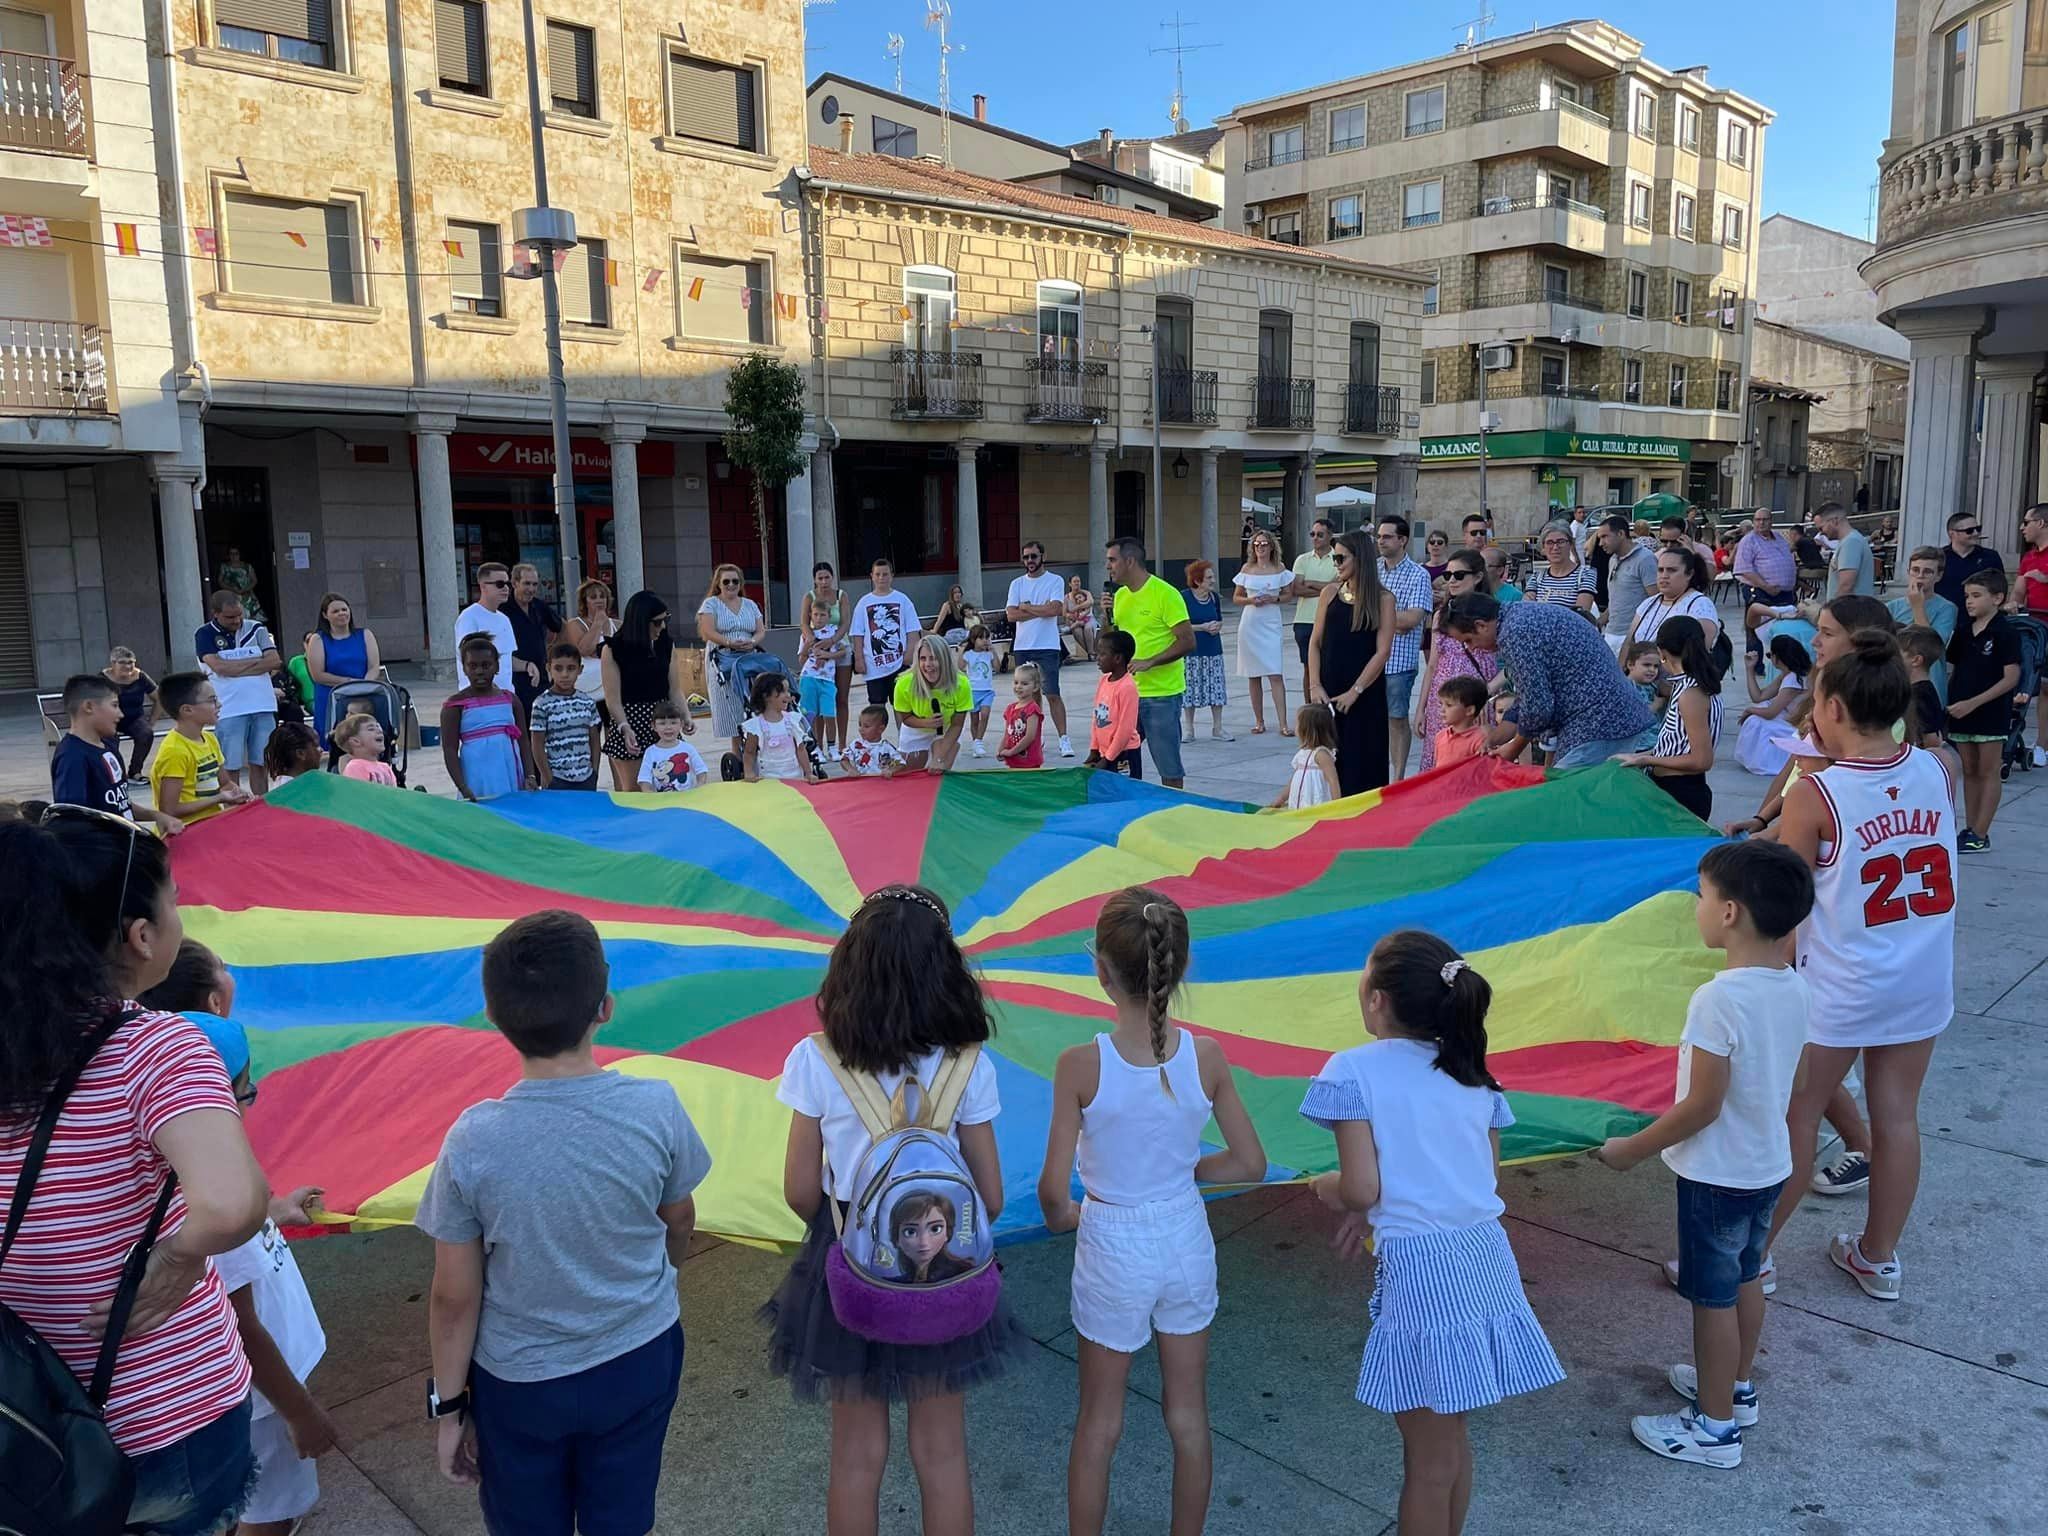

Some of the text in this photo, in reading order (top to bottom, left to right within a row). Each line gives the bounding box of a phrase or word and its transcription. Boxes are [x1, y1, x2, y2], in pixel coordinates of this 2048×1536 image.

[515, 447, 587, 465] Halcn
[1581, 440, 1679, 457] CAJA RURAL DE SALAMANCA
[1855, 809, 1942, 852] JORDAN
[1860, 842, 1955, 927] 23
